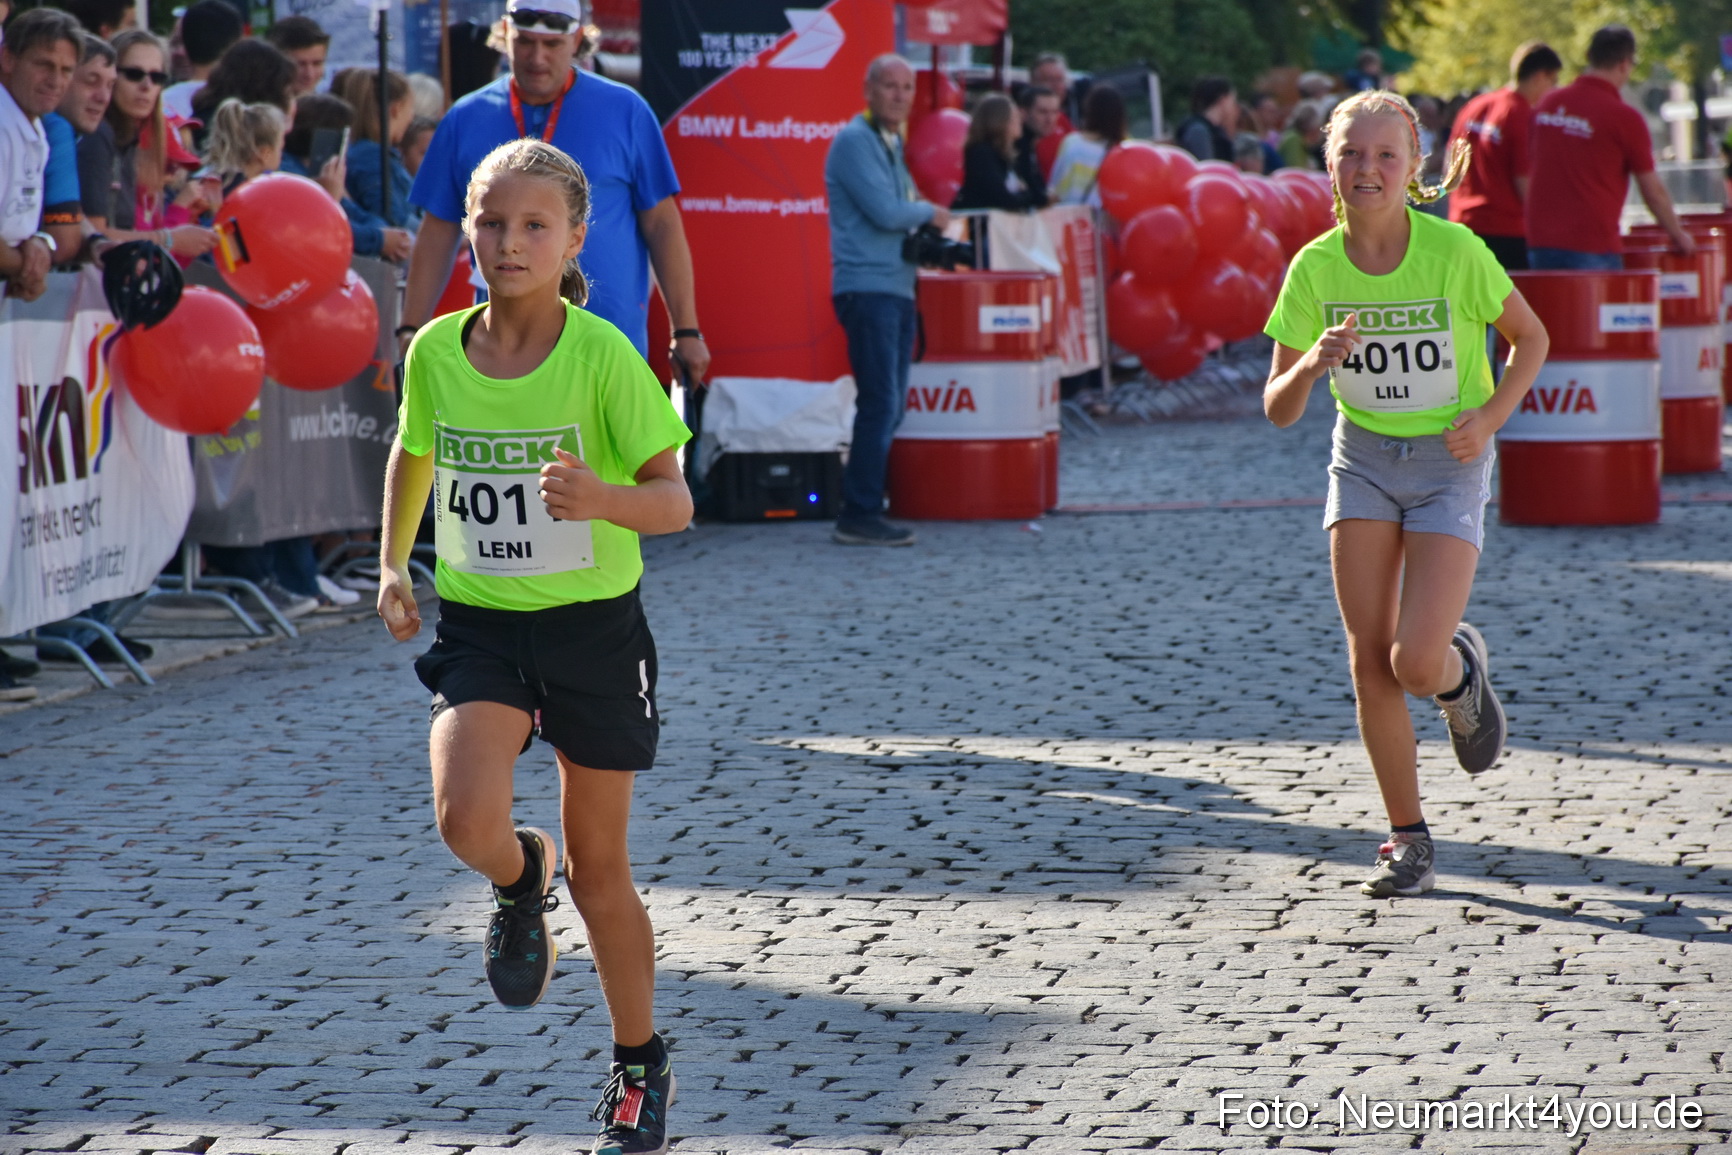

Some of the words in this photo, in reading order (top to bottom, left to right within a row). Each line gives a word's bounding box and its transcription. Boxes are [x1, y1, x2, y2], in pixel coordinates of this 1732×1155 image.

[701, 32, 731, 51] THE
[733, 32, 780, 51] NEXT
[678, 50, 703, 68] 100
[704, 50, 759, 68] YEARS
[678, 114, 735, 137] BMW
[1342, 339, 1441, 374] 4010
[1375, 385, 1410, 400] LILI
[441, 432, 564, 468] BOCK
[448, 479, 563, 526] 401
[477, 540, 533, 560] LENI
